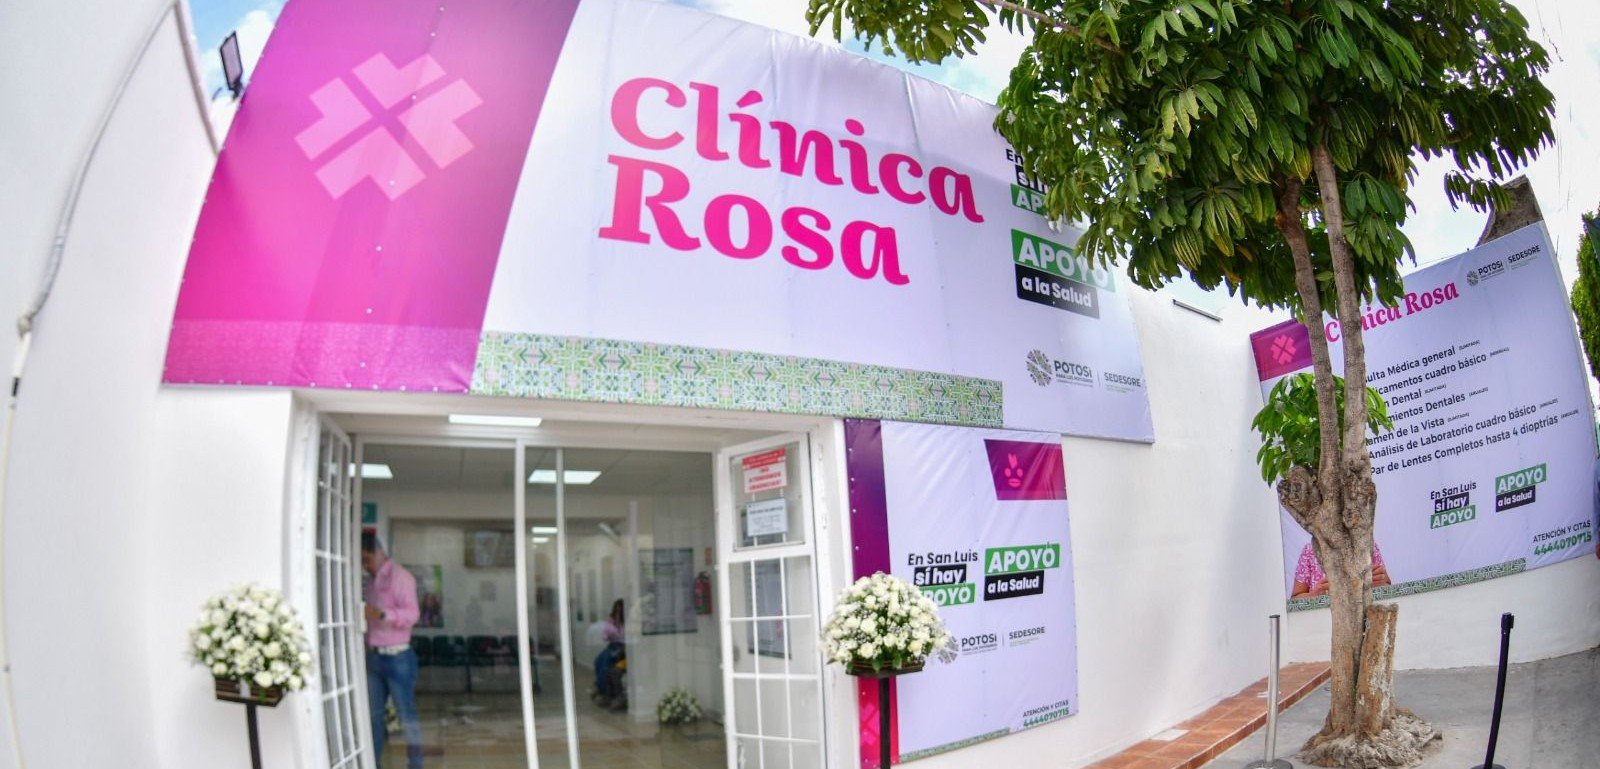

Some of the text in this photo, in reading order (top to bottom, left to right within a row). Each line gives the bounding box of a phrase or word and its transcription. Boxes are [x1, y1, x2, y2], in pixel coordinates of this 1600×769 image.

[610, 77, 984, 223] Clínica
[1006, 148, 1024, 166] En
[598, 154, 910, 285] Rosa
[1508, 245, 1540, 263] SEDESORE
[1022, 276, 1092, 308] a la Salud
[1404, 282, 1460, 316] Rosa
[1366, 371, 1385, 383] ulta
[1388, 359, 1420, 376] Médica
[1423, 346, 1456, 367] general
[1375, 375, 1423, 395] icamentos
[1425, 364, 1456, 380] cuadro
[1458, 353, 1487, 370] básico
[1104, 372, 1141, 388] SEDESORE
[1392, 388, 1422, 406] Dental
[1388, 406, 1424, 422] mientos
[1426, 393, 1466, 412] Dentales
[1368, 404, 1536, 460] Análisis de Laboratorio cuadro básico
[1396, 428, 1408, 438] de
[1410, 424, 1419, 434] la
[1420, 418, 1444, 430] Vista
[1388, 462, 1399, 472] de
[1402, 453, 1432, 468] Lentes
[1434, 438, 1484, 459] Completos
[1486, 430, 1510, 444] hasta
[1512, 427, 1518, 436] 4
[1520, 414, 1558, 434] dioptrías
[1430, 482, 1476, 500] En San Luis
[1504, 496, 1512, 506] la
[1512, 490, 1532, 504] Salud
[1436, 496, 1467, 512] sí hay
[1432, 508, 1472, 528] APOYO
[1572, 520, 1591, 532] CITAS
[908, 550, 978, 566] En San Luis
[916, 567, 964, 586] sí hay
[988, 576, 1040, 594] a la Salud
[922, 586, 971, 606] POYO
[1009, 626, 1045, 640] SEDESORE
[1055, 700, 1068, 708] CITAS
